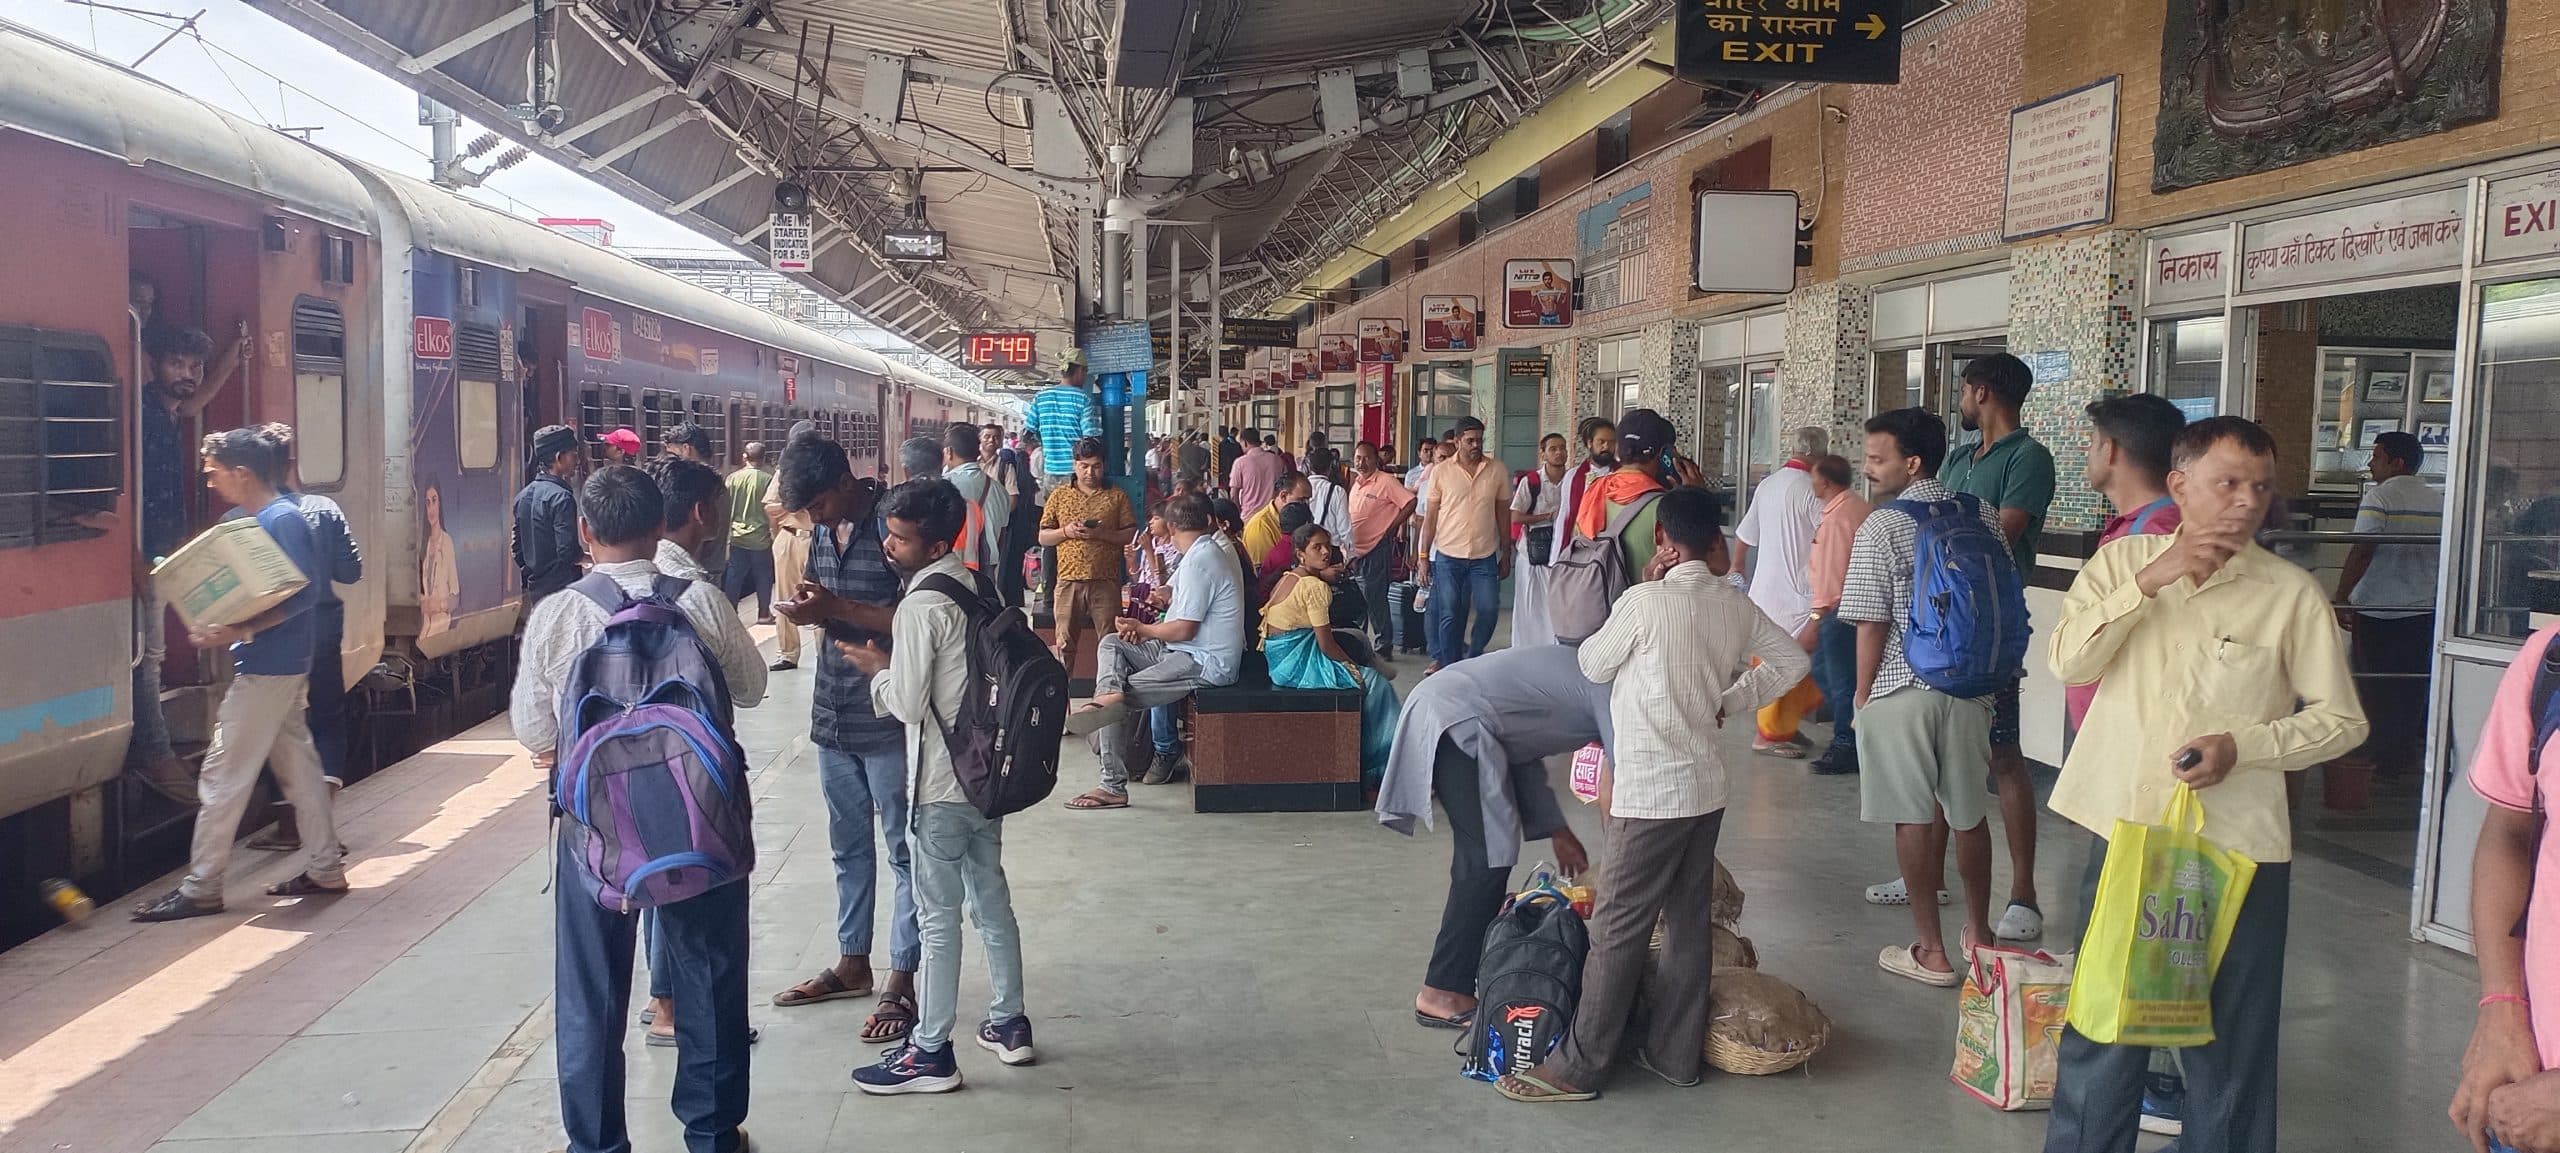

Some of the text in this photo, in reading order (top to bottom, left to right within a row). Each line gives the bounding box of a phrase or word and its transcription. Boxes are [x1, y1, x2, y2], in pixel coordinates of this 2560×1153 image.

[1705, 14, 1838, 36] का रास्ता
[1721, 41, 1823, 63] EXIT
[2504, 200, 2558, 237] EXI
[774, 227, 808, 238] STARTER
[774, 238, 808, 248] INDICATOR
[2304, 233, 2338, 264] टिकट
[2158, 248, 2222, 285] निकास
